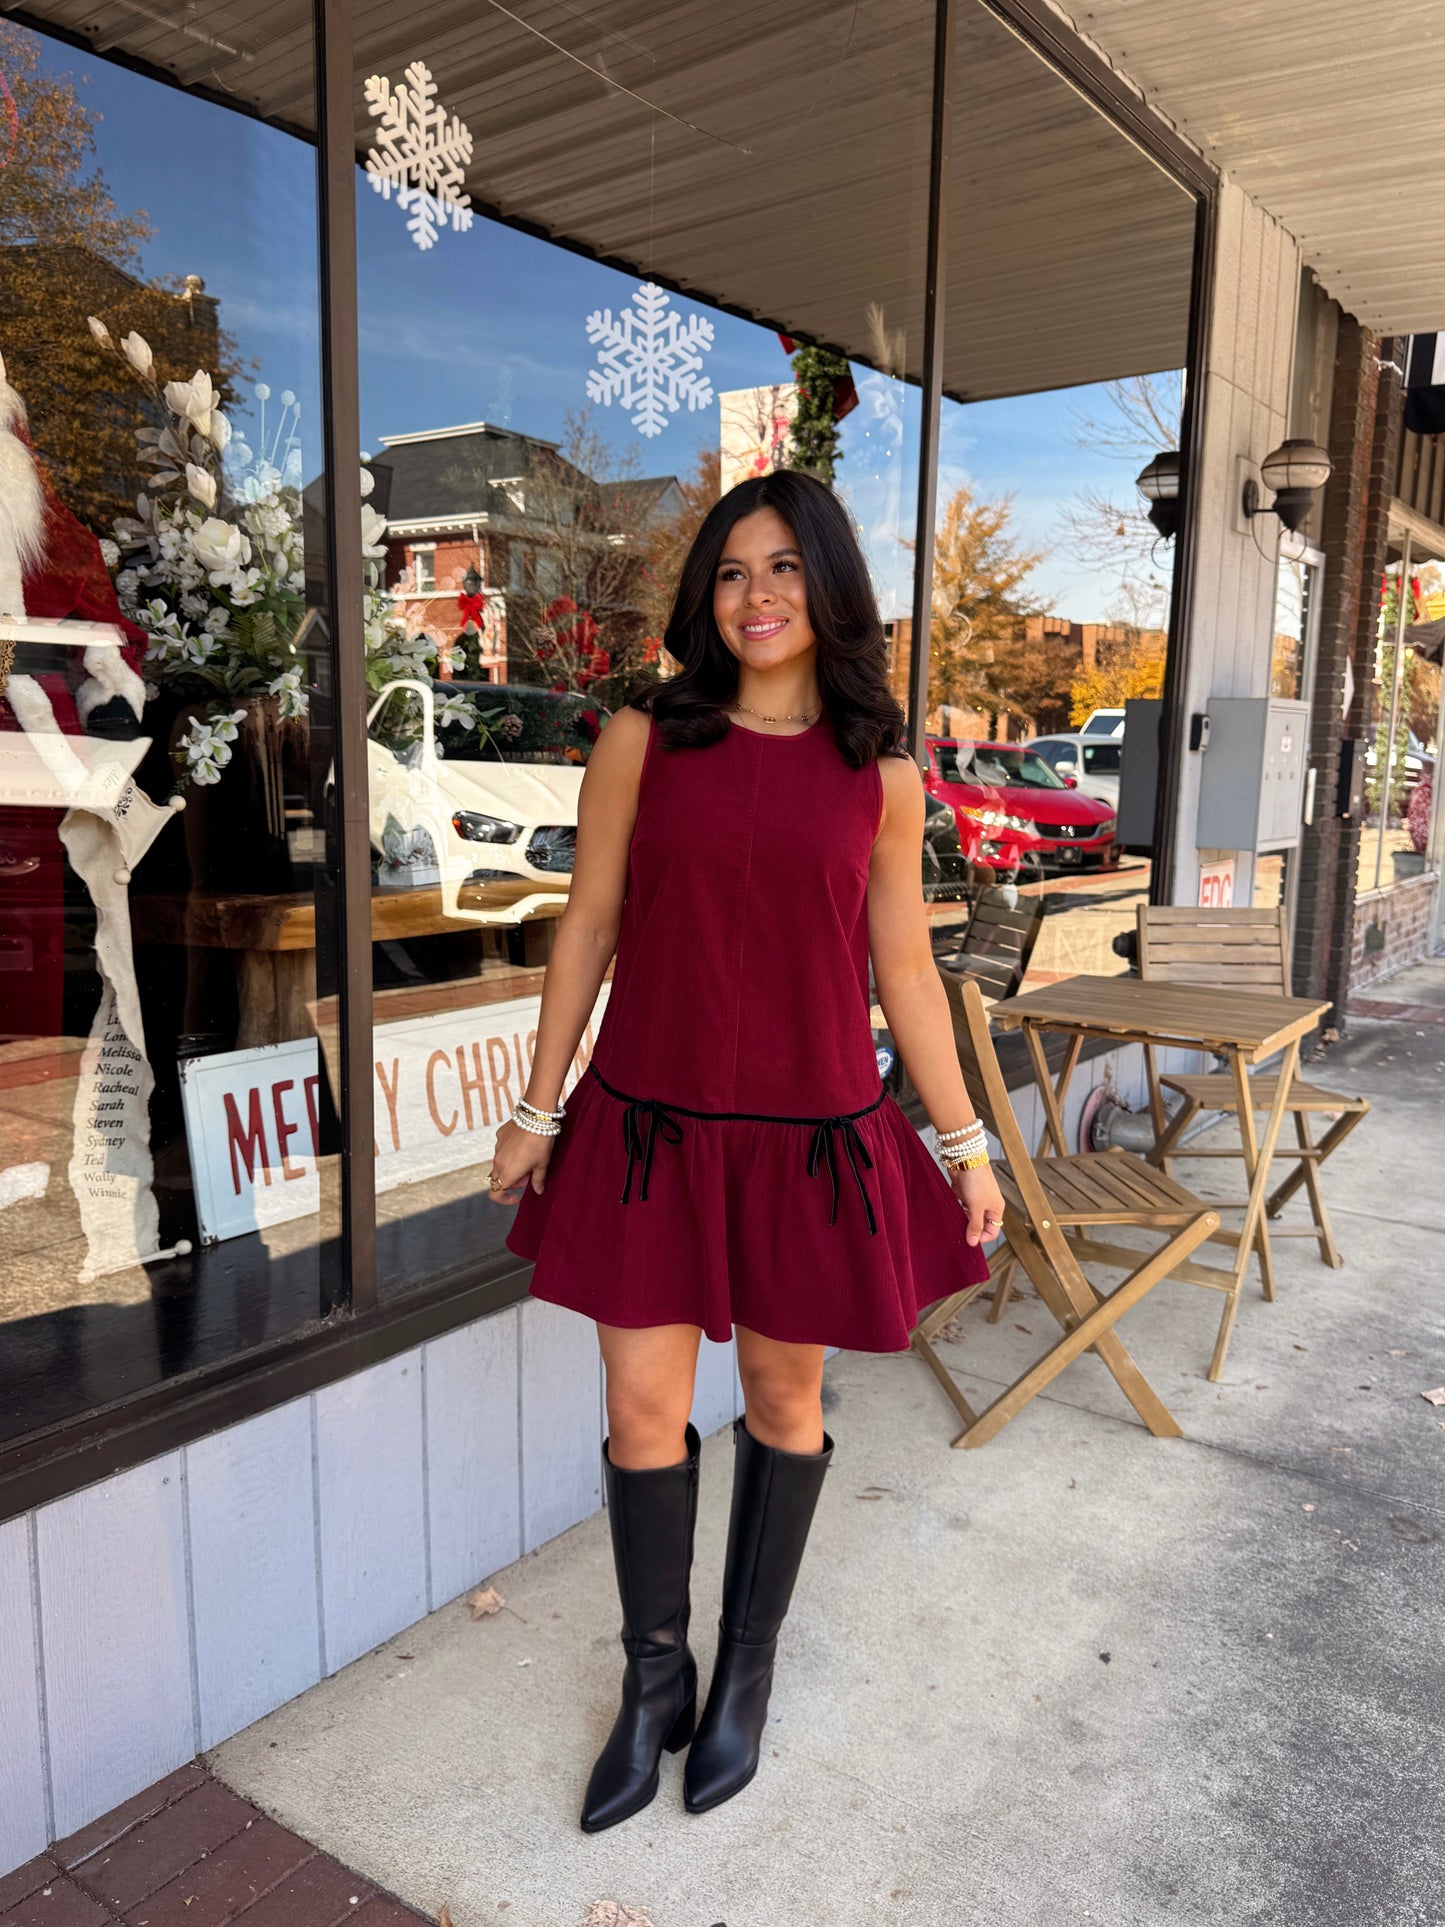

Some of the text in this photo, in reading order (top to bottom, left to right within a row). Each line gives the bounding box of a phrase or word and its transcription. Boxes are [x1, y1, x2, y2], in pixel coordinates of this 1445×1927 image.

[103, 1032, 128, 1042] Lon
[97, 1047, 142, 1062] Melissa
[94, 1063, 134, 1076] Nicole
[93, 1080, 139, 1096] Racheal
[89, 1099, 125, 1111] Sarah
[86, 1117, 124, 1129] Steven
[85, 1135, 126, 1150] Sydney
[83, 1153, 105, 1166] Ted
[84, 1171, 116, 1185] Wally
